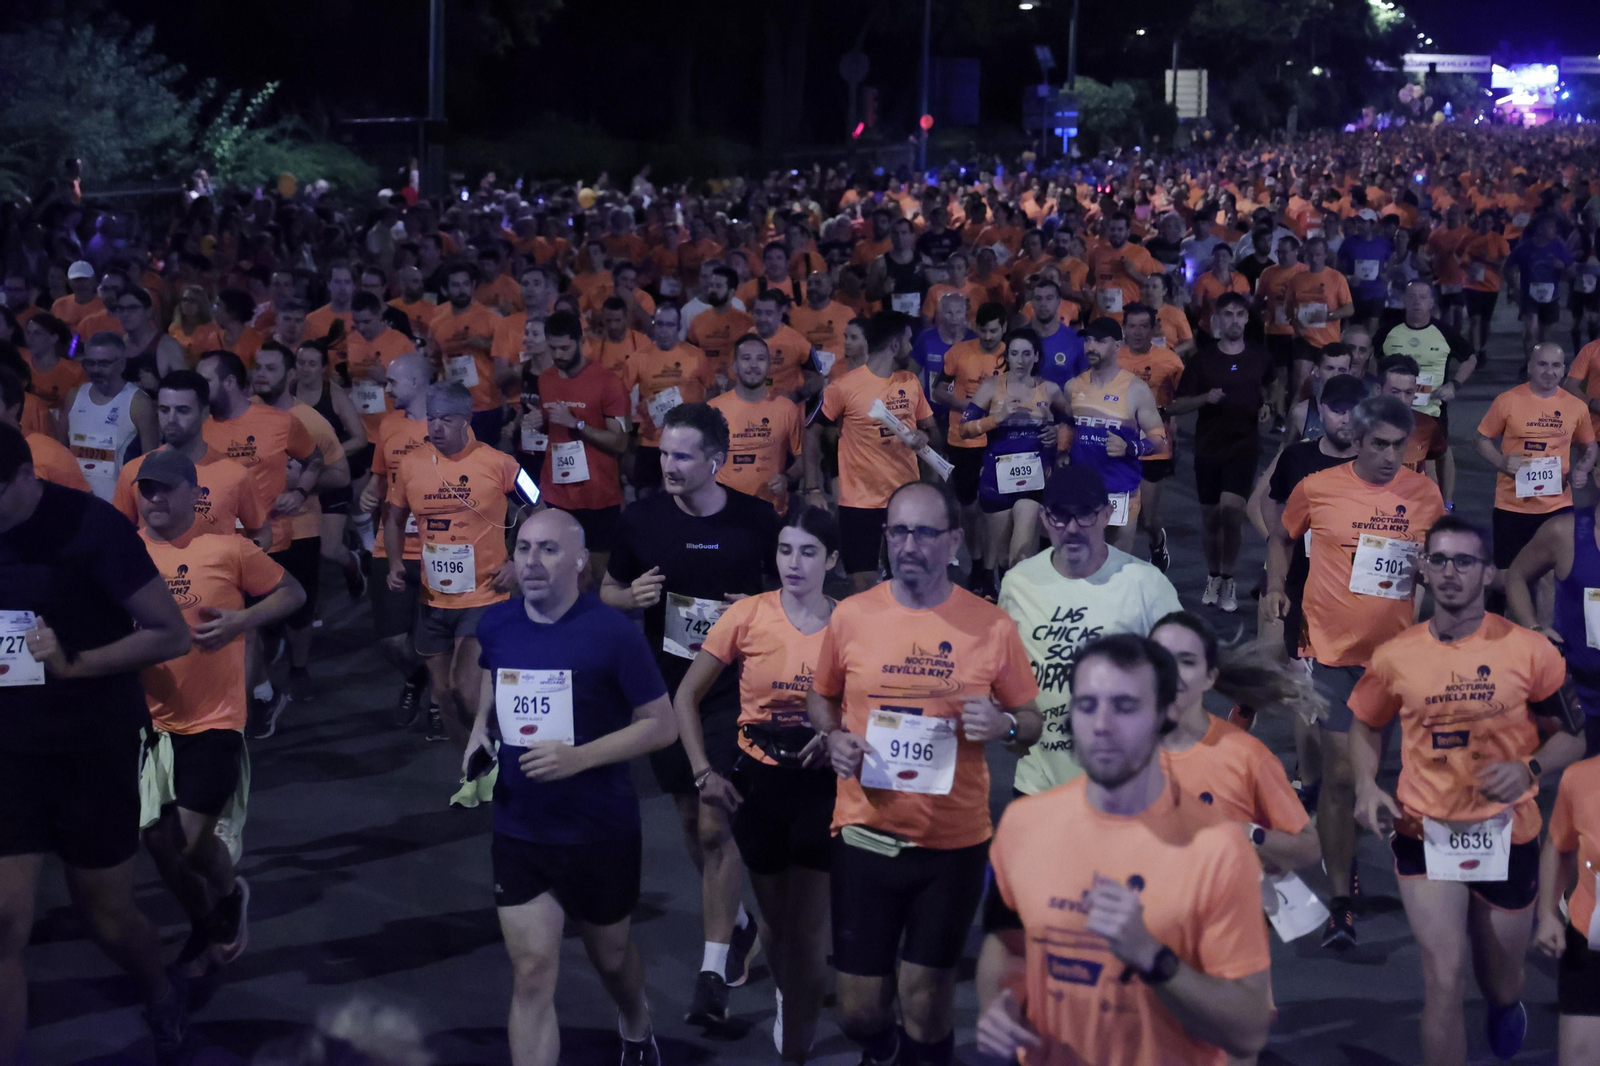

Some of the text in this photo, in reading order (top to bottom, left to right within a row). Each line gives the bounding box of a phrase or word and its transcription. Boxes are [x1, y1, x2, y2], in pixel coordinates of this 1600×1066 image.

[1009, 467, 1032, 478] 4939
[1526, 470, 1553, 481] 12103
[1351, 521, 1388, 531] SEVILLA
[1370, 516, 1410, 526] NOCTURNA
[431, 560, 463, 573] 15196
[1374, 557, 1404, 576] 5101
[1051, 606, 1088, 623] LAS
[685, 618, 716, 636] 742
[1032, 625, 1104, 643] CHICAS
[904, 656, 955, 669] NOCTURNA
[881, 664, 926, 676] SEVILLA
[1445, 683, 1496, 692] NOCTURNA
[513, 696, 550, 714] 2615
[1425, 692, 1468, 705] SEVILLA
[890, 739, 934, 761] 9196
[1449, 833, 1494, 849] 6636
